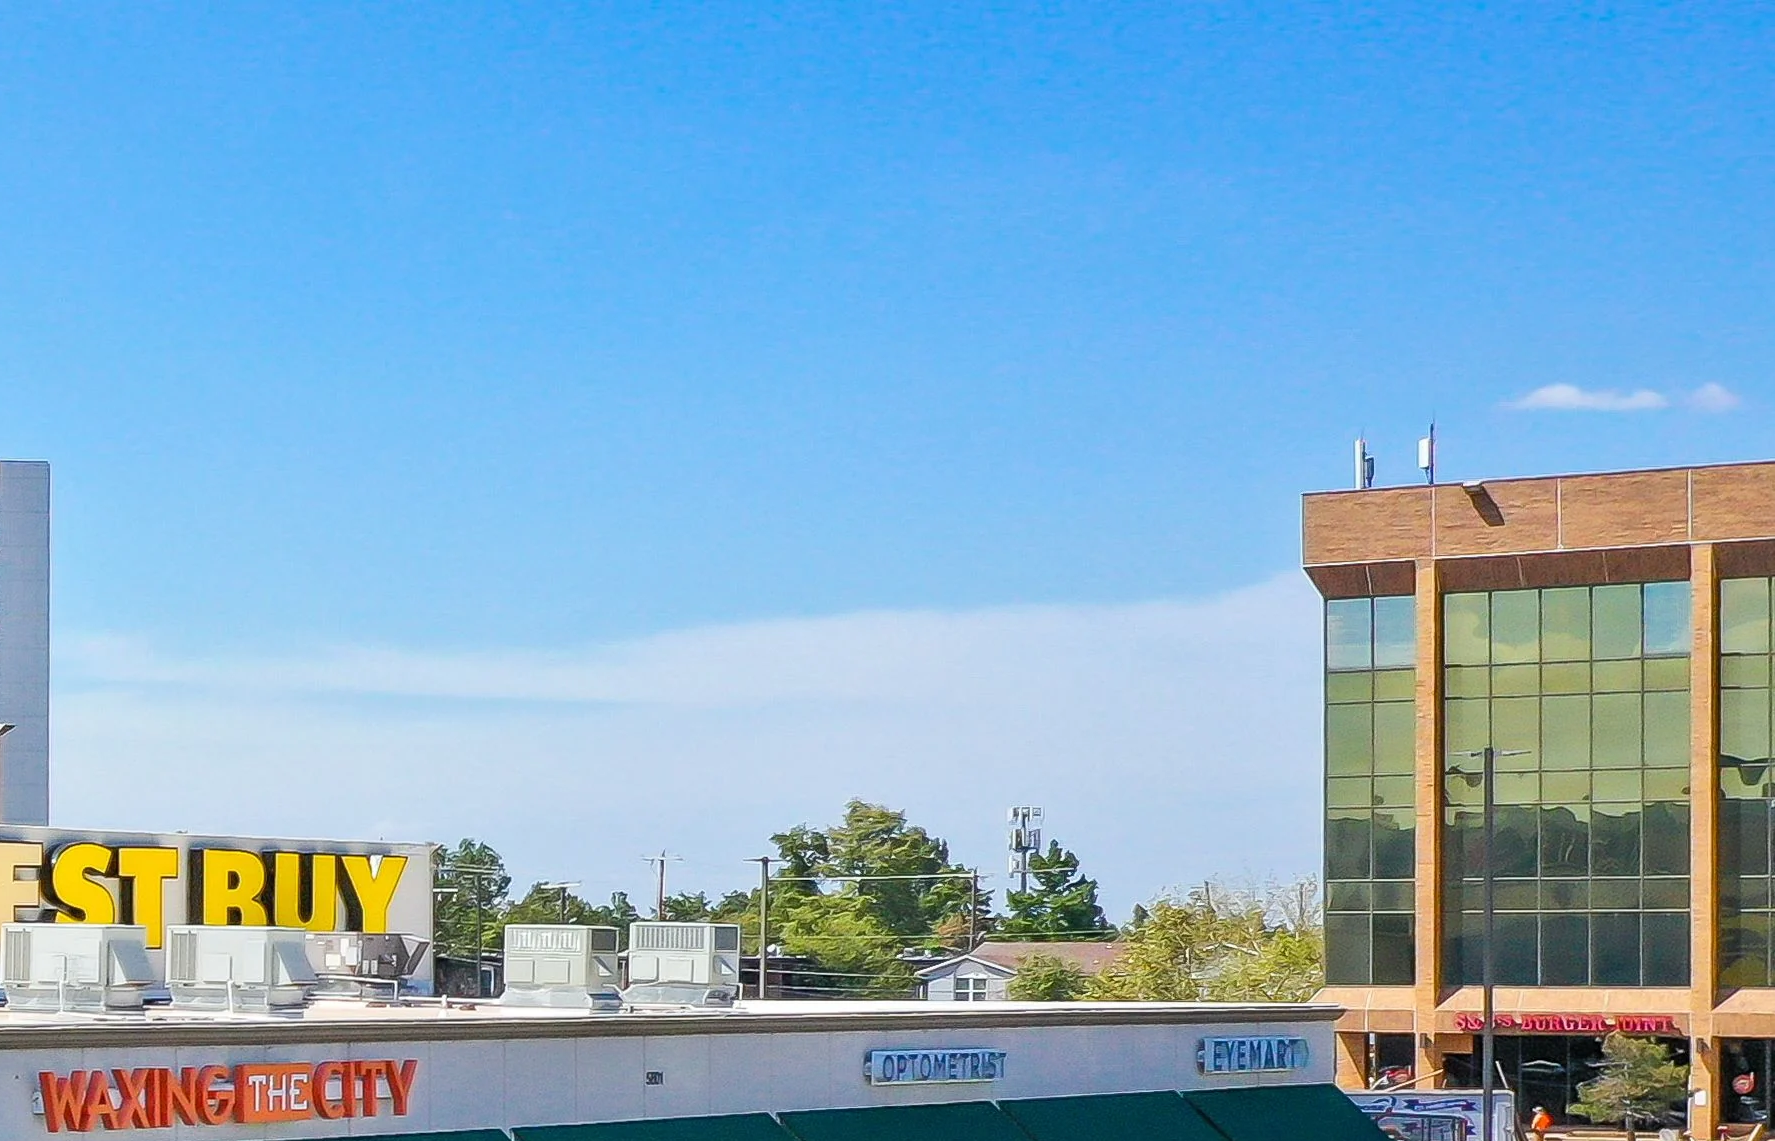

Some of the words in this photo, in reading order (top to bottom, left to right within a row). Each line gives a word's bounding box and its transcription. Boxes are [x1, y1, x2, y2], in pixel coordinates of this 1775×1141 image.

[198, 848, 409, 934] BUY
[1521, 1015, 1606, 1031] BURGER
[882, 1052, 1007, 1082] OPTOMETRIST
[1213, 1040, 1295, 1071] EYEMART
[39, 1065, 236, 1132] WAXING
[249, 1074, 308, 1112] THE
[312, 1060, 417, 1120] CITY
